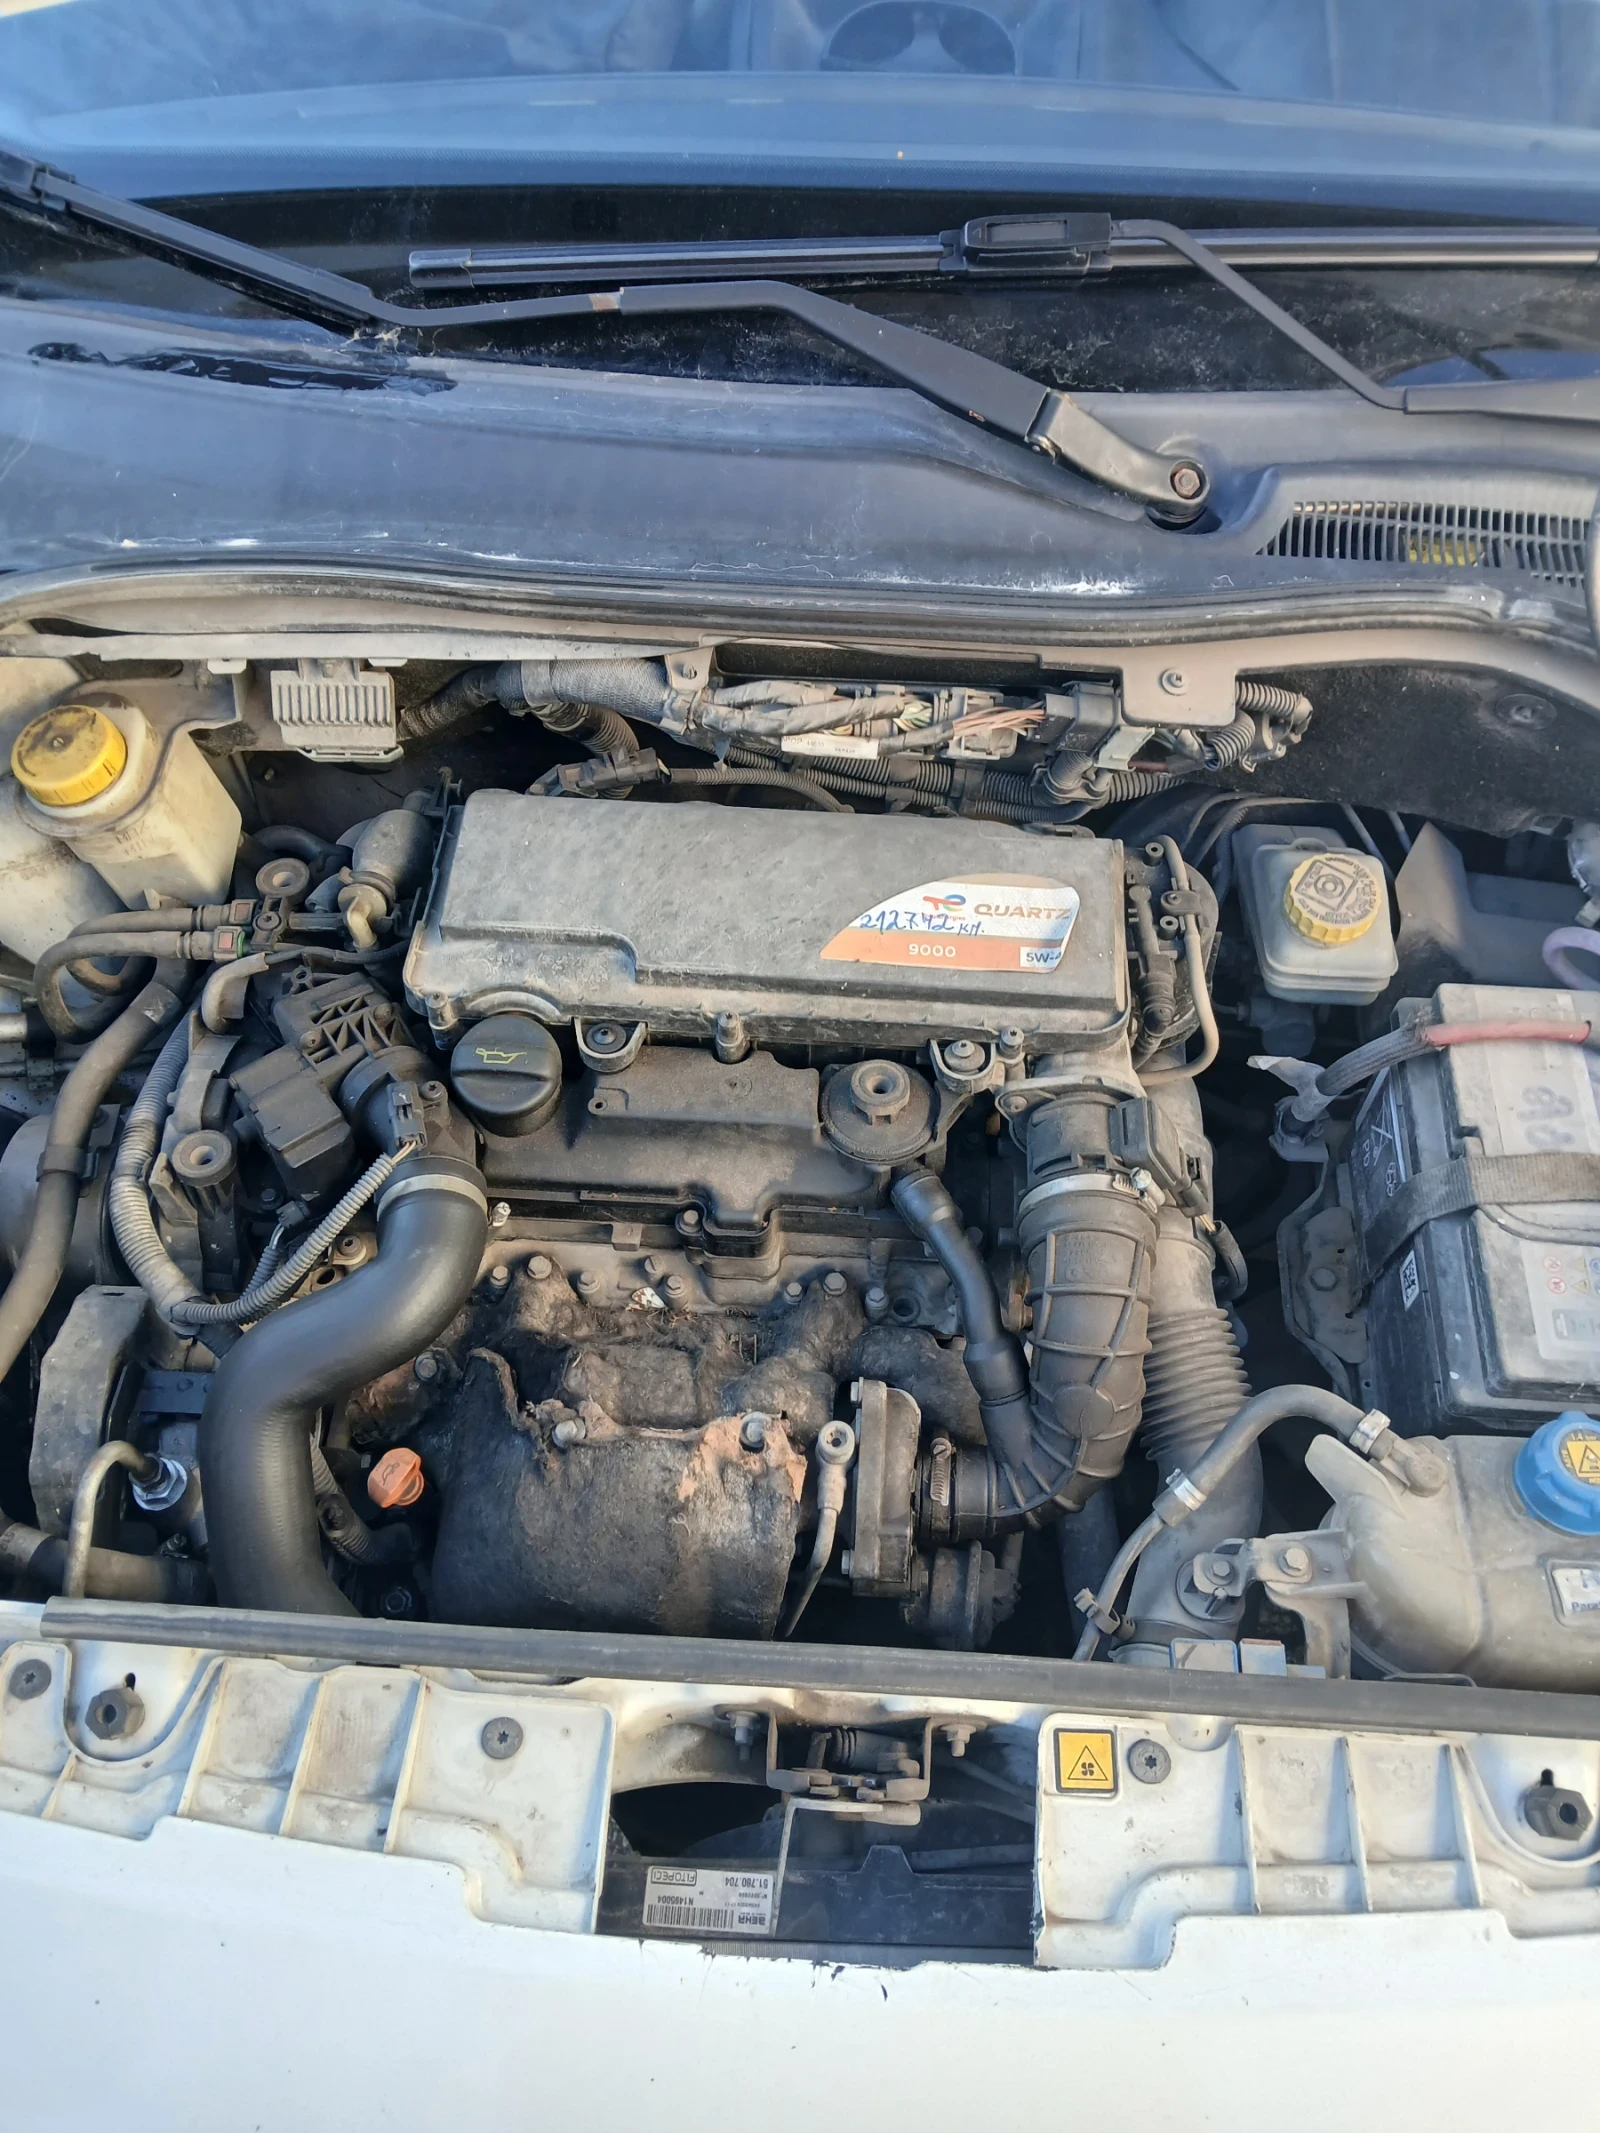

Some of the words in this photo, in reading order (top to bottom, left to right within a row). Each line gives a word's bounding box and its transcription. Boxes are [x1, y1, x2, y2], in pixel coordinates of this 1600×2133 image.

[973, 903, 1070, 920] QUARTZ
[908, 943, 956, 958] 9000
[1571, 1600, 1600, 1612] Para
[738, 1915, 766, 1926] BEHR
